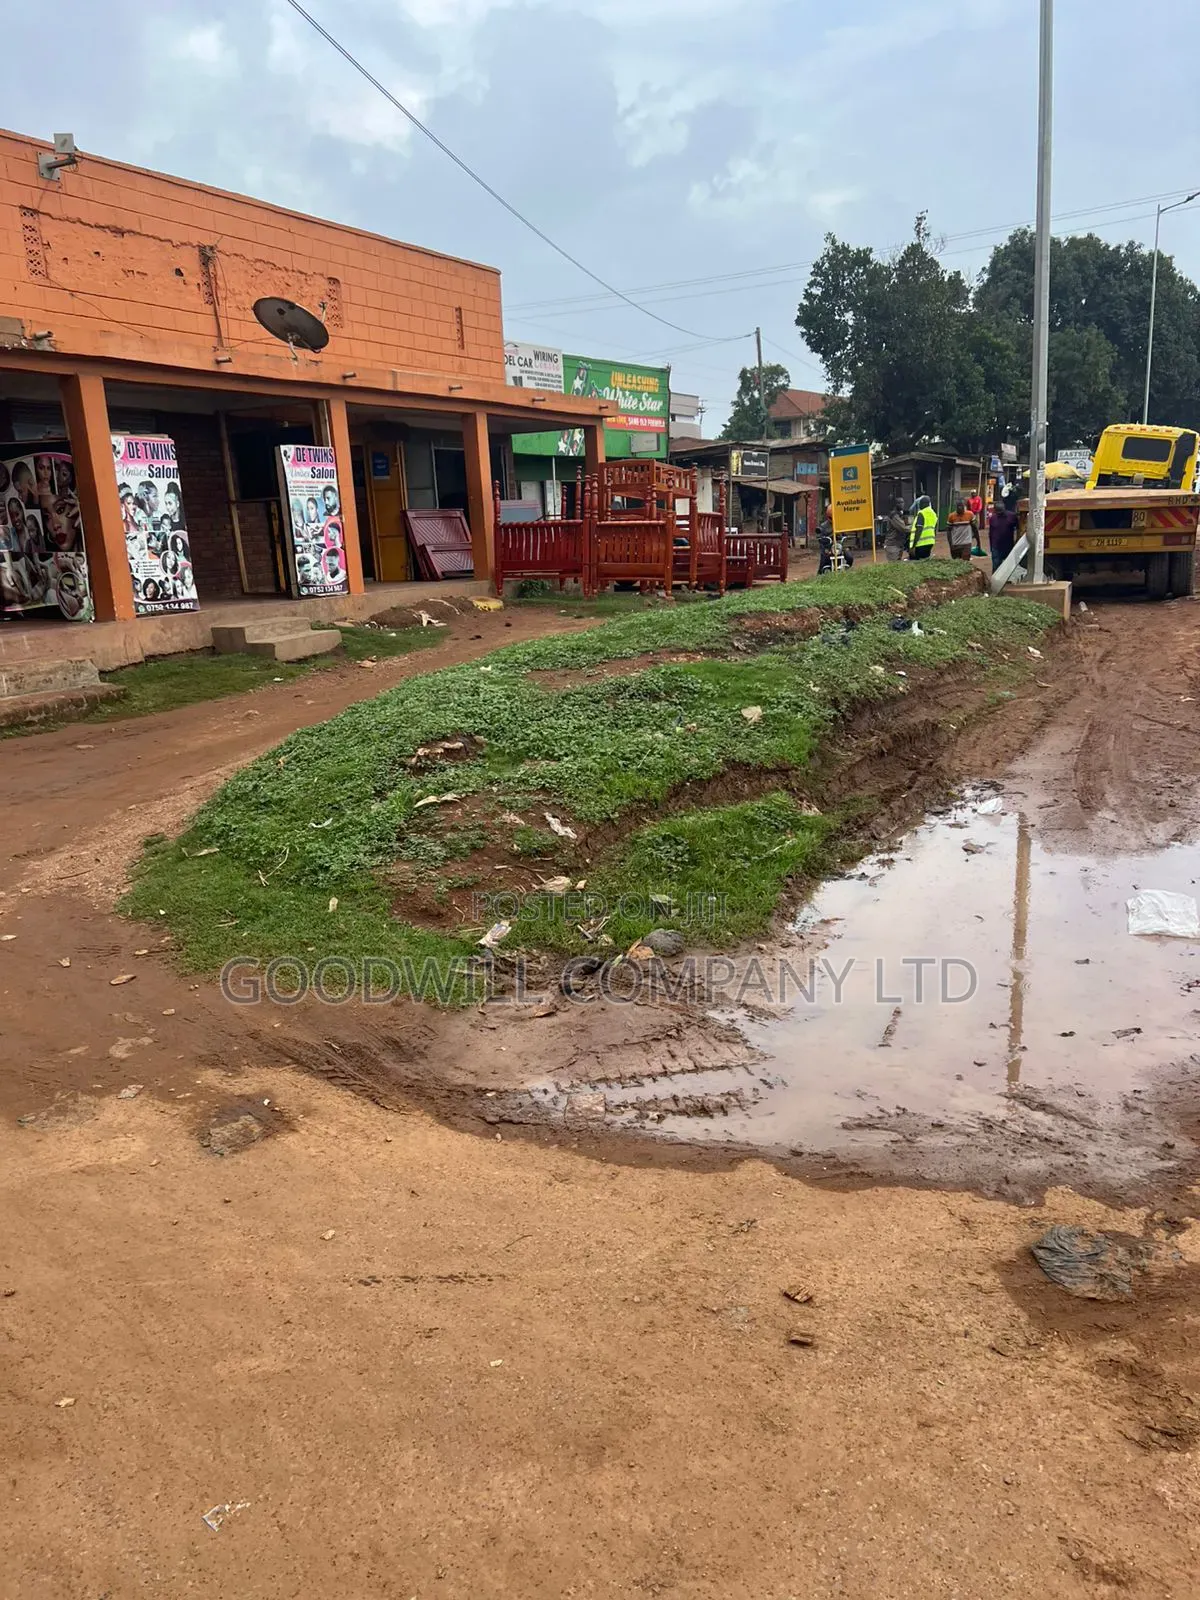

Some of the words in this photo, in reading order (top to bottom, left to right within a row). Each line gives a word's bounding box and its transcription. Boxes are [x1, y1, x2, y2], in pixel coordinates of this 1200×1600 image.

[517, 356, 533, 368] CAR
[533, 350, 559, 364] WIRING
[611, 371, 660, 392] UNLEASHING
[602, 387, 638, 410] White
[639, 393, 664, 412] Star
[127, 441, 141, 459] DE
[142, 442, 177, 460] TWINS
[295, 447, 306, 462] DE
[307, 448, 334, 463] TWINS
[148, 464, 179, 479] Salon
[310, 466, 335, 479] Salon
[836, 498, 867, 506] Available
[1134, 511, 1145, 521] 80
